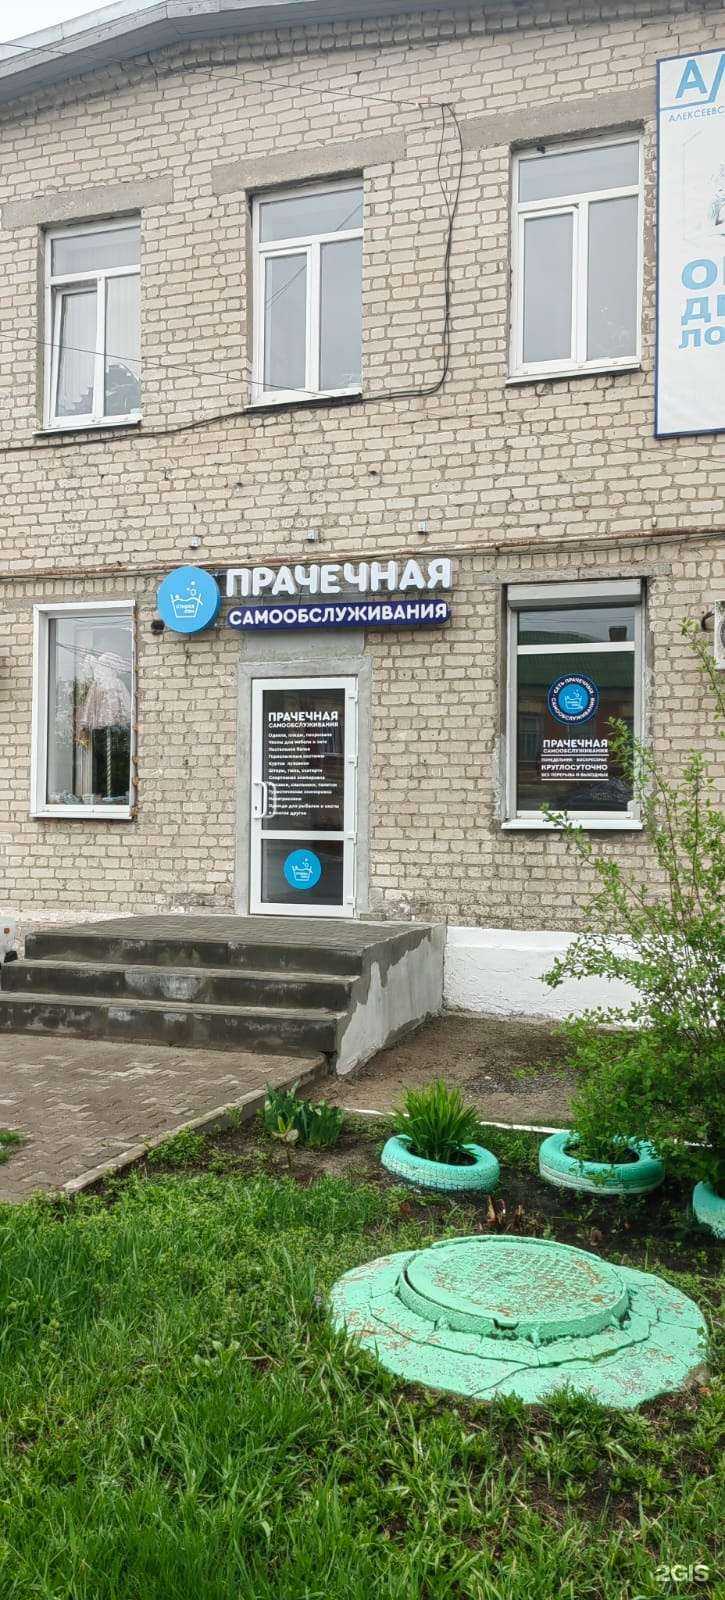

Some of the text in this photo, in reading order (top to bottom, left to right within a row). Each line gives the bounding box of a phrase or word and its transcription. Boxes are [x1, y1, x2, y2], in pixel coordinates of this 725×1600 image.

[681, 256, 725, 290] О
[226, 557, 451, 598] ПРАЧЕЧНАЯ
[229, 602, 448, 626] САМООБСЛУЖИВАНИЯ
[268, 711, 338, 721] ПРАЧЕЧНАЯ
[543, 739, 608, 748] ПРАЧЕЧНАЯ
